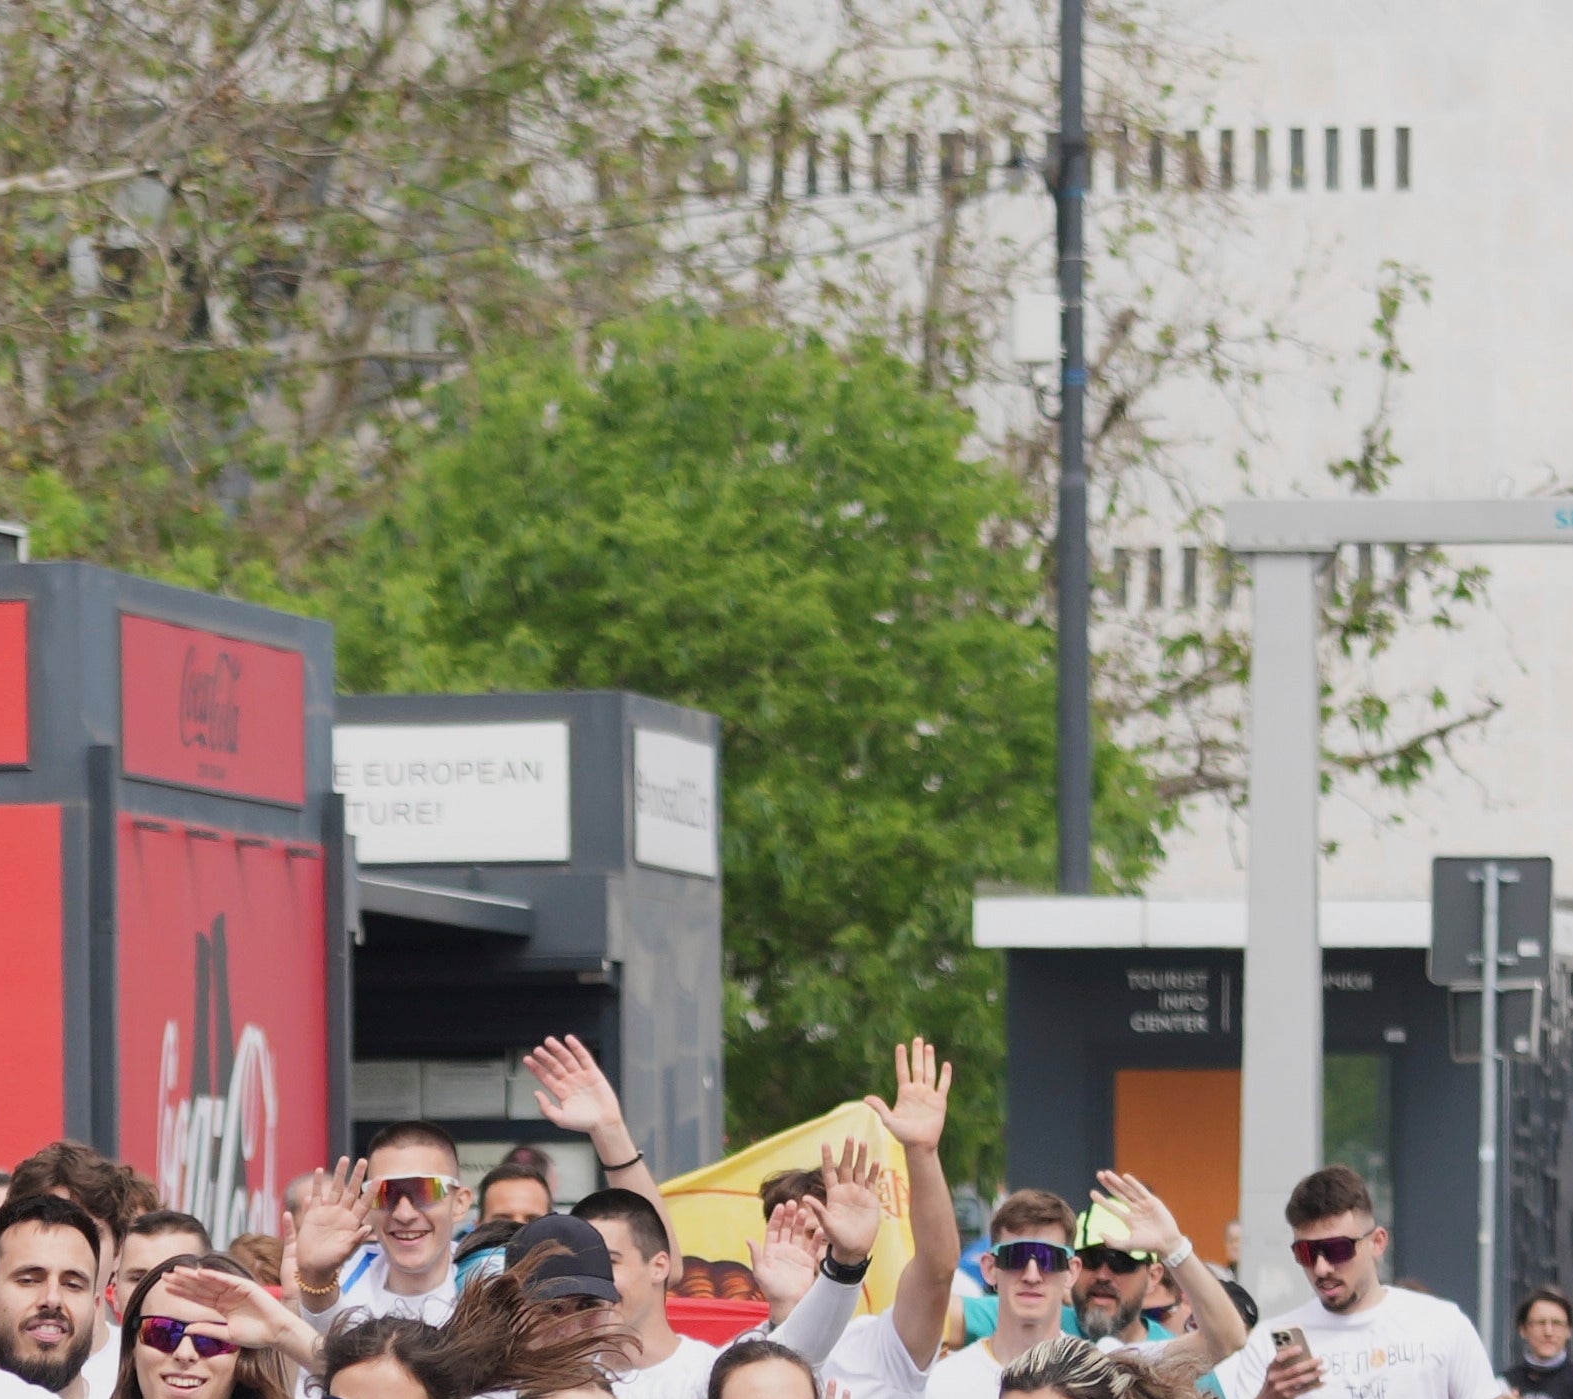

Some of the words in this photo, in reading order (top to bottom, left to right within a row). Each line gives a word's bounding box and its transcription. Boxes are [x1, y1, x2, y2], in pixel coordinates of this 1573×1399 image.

[364, 760, 544, 787] EUROPEAN
[1126, 970, 1209, 991] TOURIST
[1157, 992, 1209, 1012] INFO
[1129, 1012, 1209, 1033] CENTER
